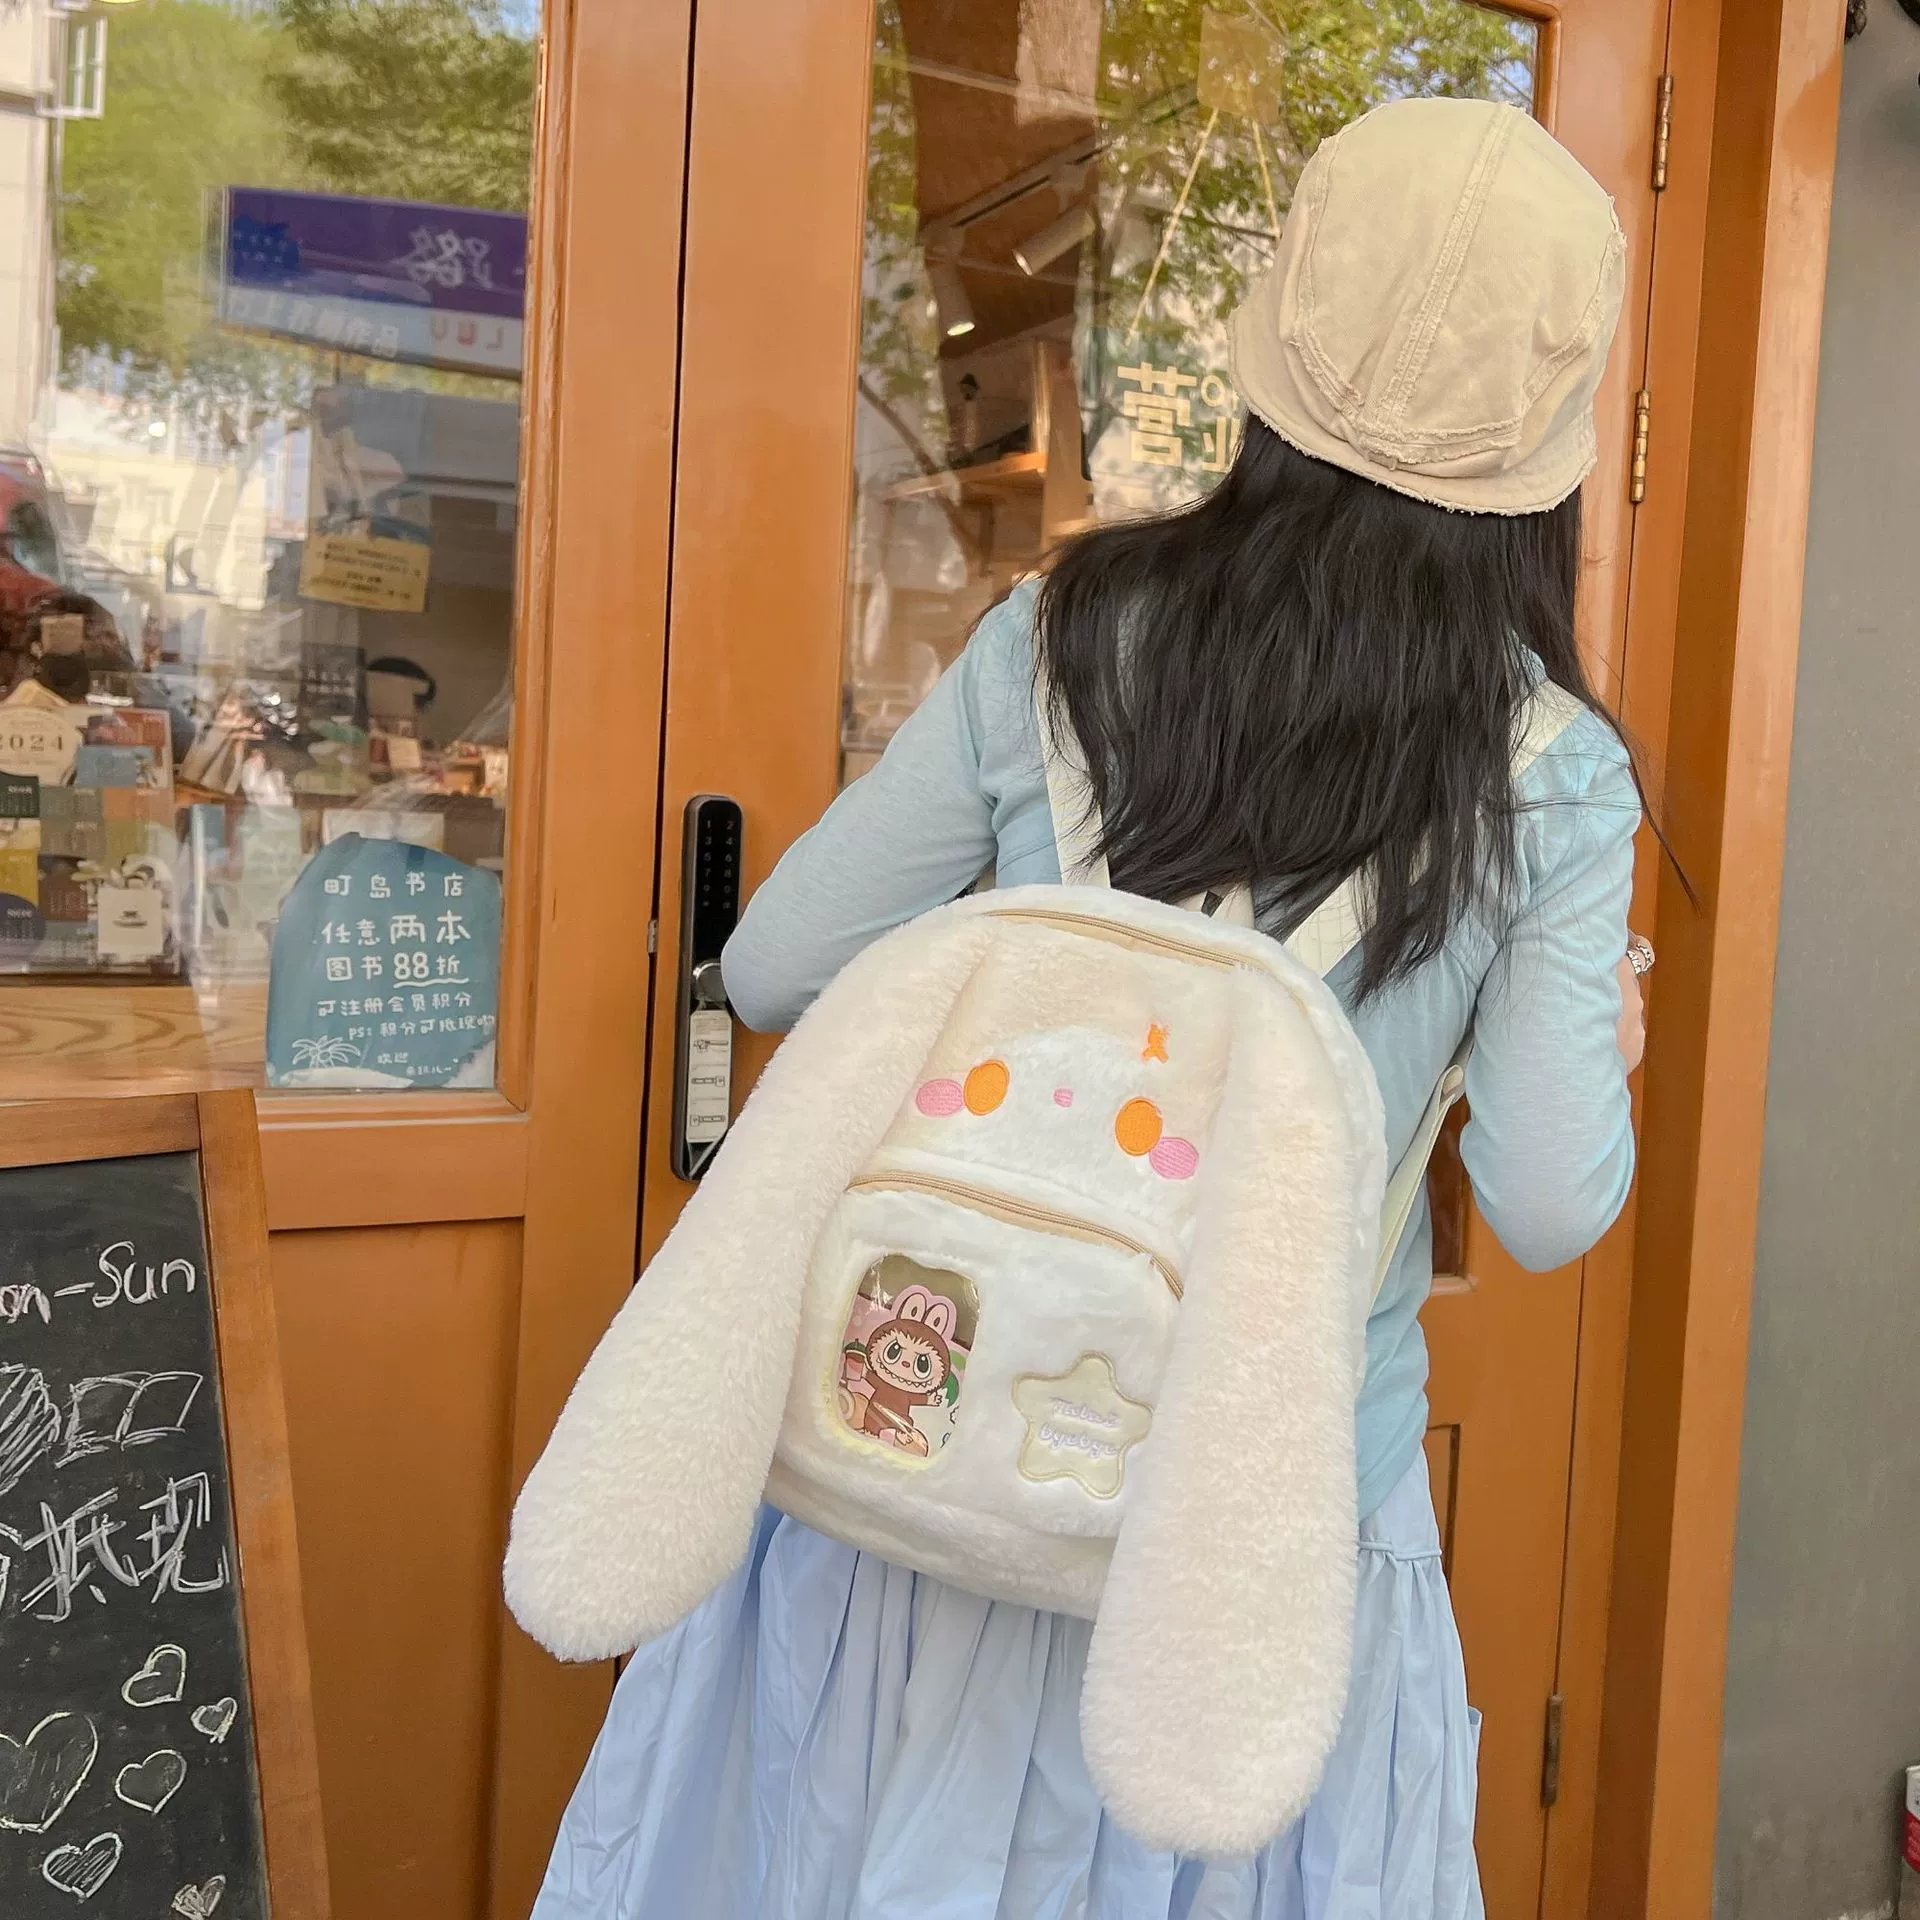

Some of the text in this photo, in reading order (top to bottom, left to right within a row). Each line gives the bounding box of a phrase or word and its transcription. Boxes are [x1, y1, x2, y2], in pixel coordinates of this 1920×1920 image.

[324, 871, 464, 898] 町岛书店
[321, 910, 471, 945] 任意两本
[326, 951, 461, 982] 图书88折
[317, 992, 472, 1016] 可注册会员积分
[0, 1471, 230, 1624] 抵现
